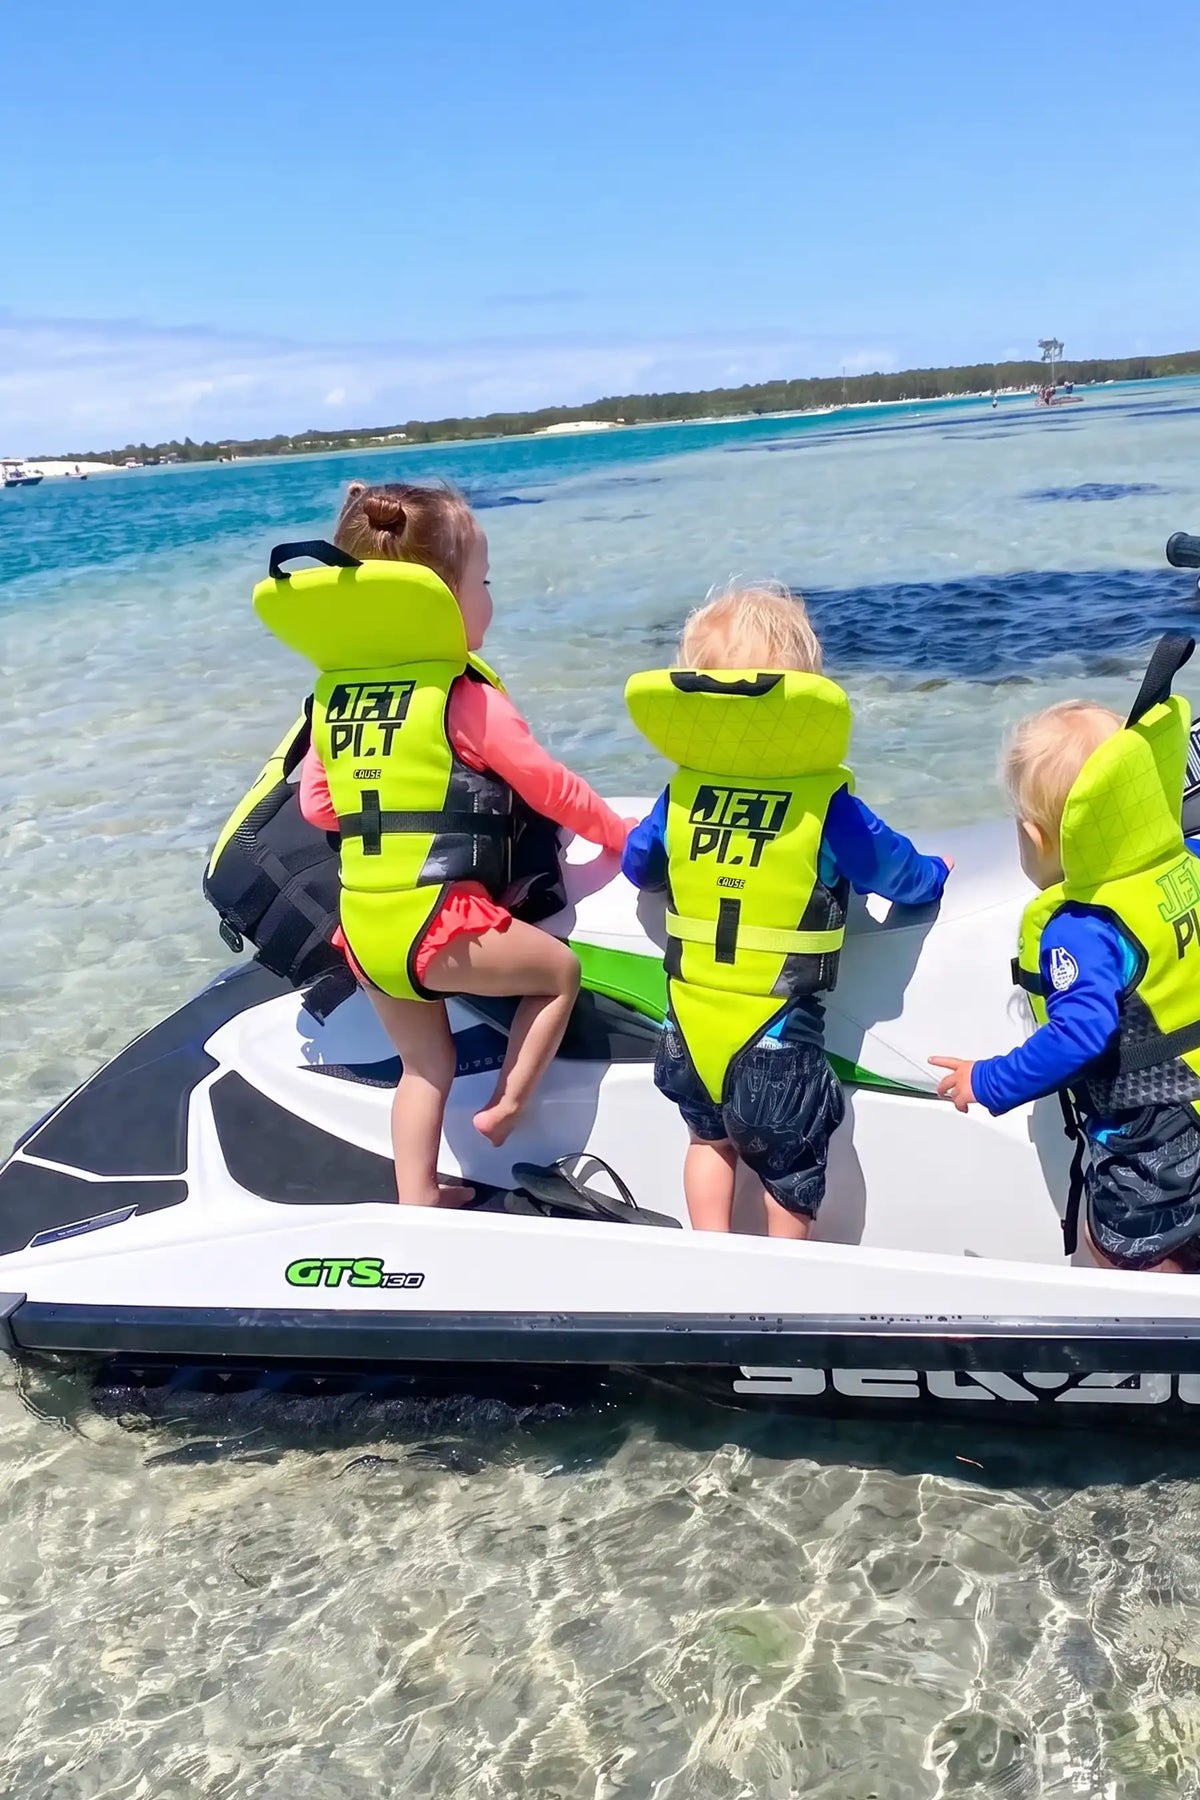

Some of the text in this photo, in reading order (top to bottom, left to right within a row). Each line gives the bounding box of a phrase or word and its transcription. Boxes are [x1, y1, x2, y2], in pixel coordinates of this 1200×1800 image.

[327, 682, 414, 722] JET
[353, 769, 382, 779] CAUSE
[690, 786, 792, 831] JET
[717, 876, 746, 889] CAUSE
[285, 1257, 425, 1288] GTS 130
